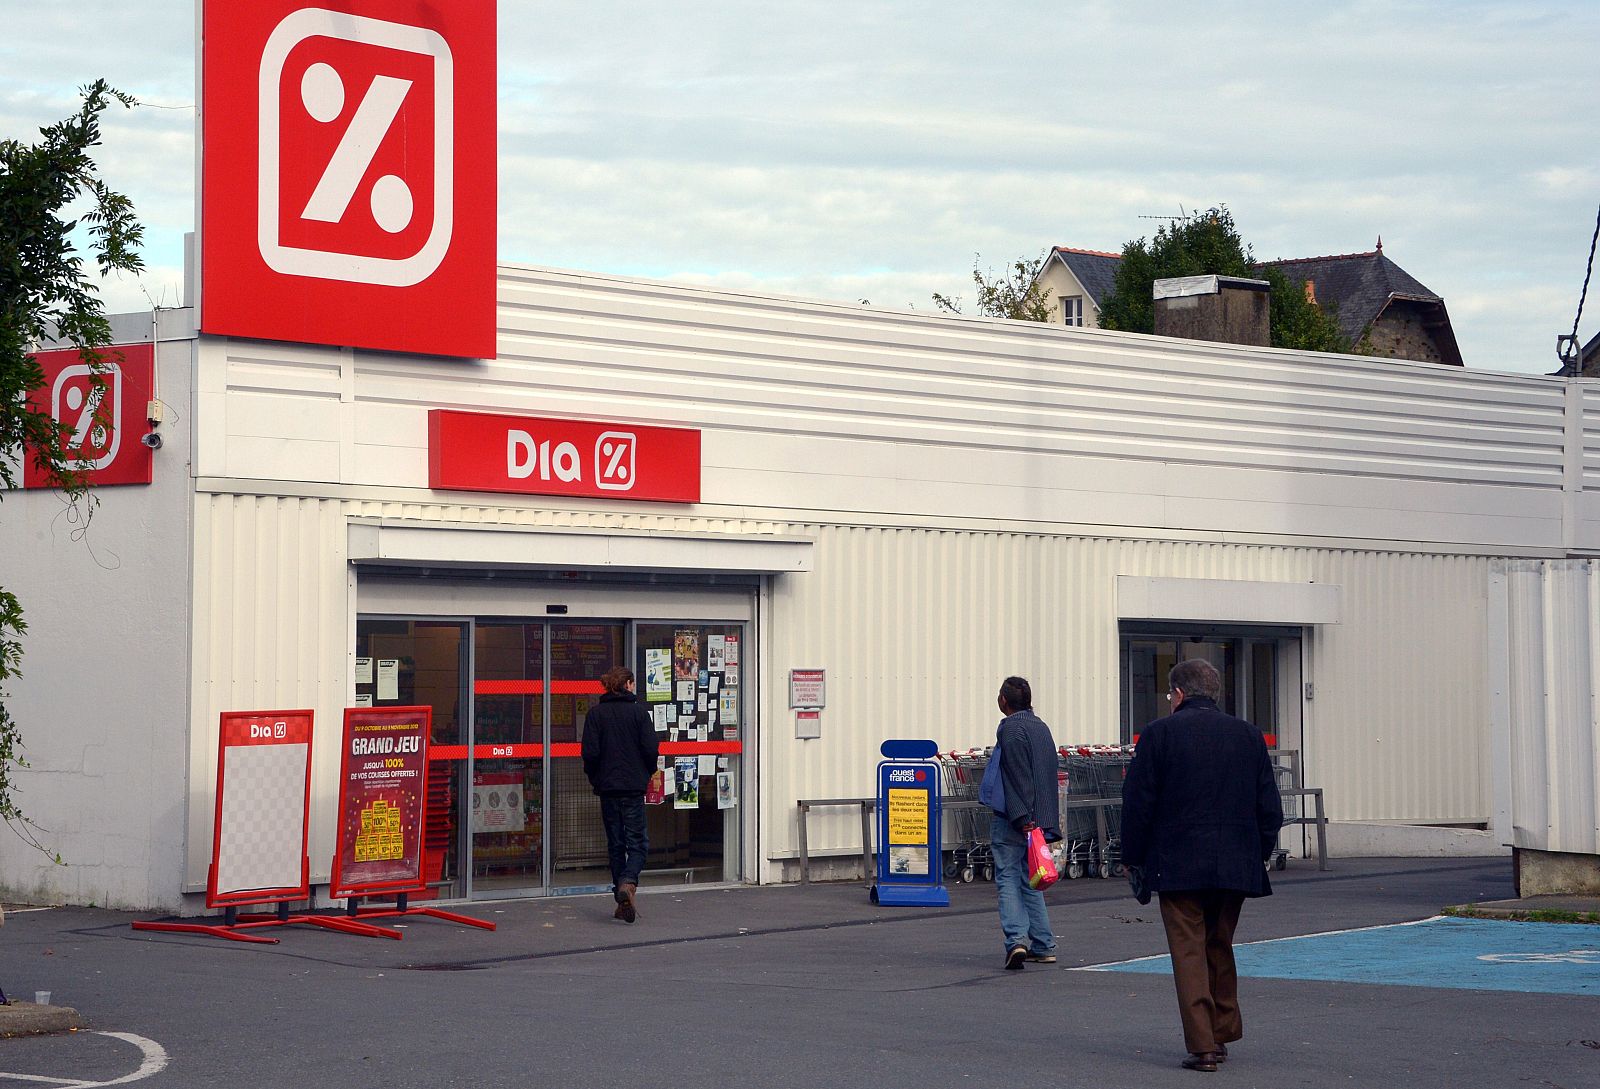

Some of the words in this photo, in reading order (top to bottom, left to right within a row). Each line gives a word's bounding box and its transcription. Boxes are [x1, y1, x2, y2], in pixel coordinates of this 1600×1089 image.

[507, 429, 582, 482] Dia
[250, 725, 272, 738] Dia
[352, 737, 394, 755] GRAND
[385, 758, 404, 768] 100%
[368, 771, 390, 779] COURSES
[889, 774, 914, 782] france
